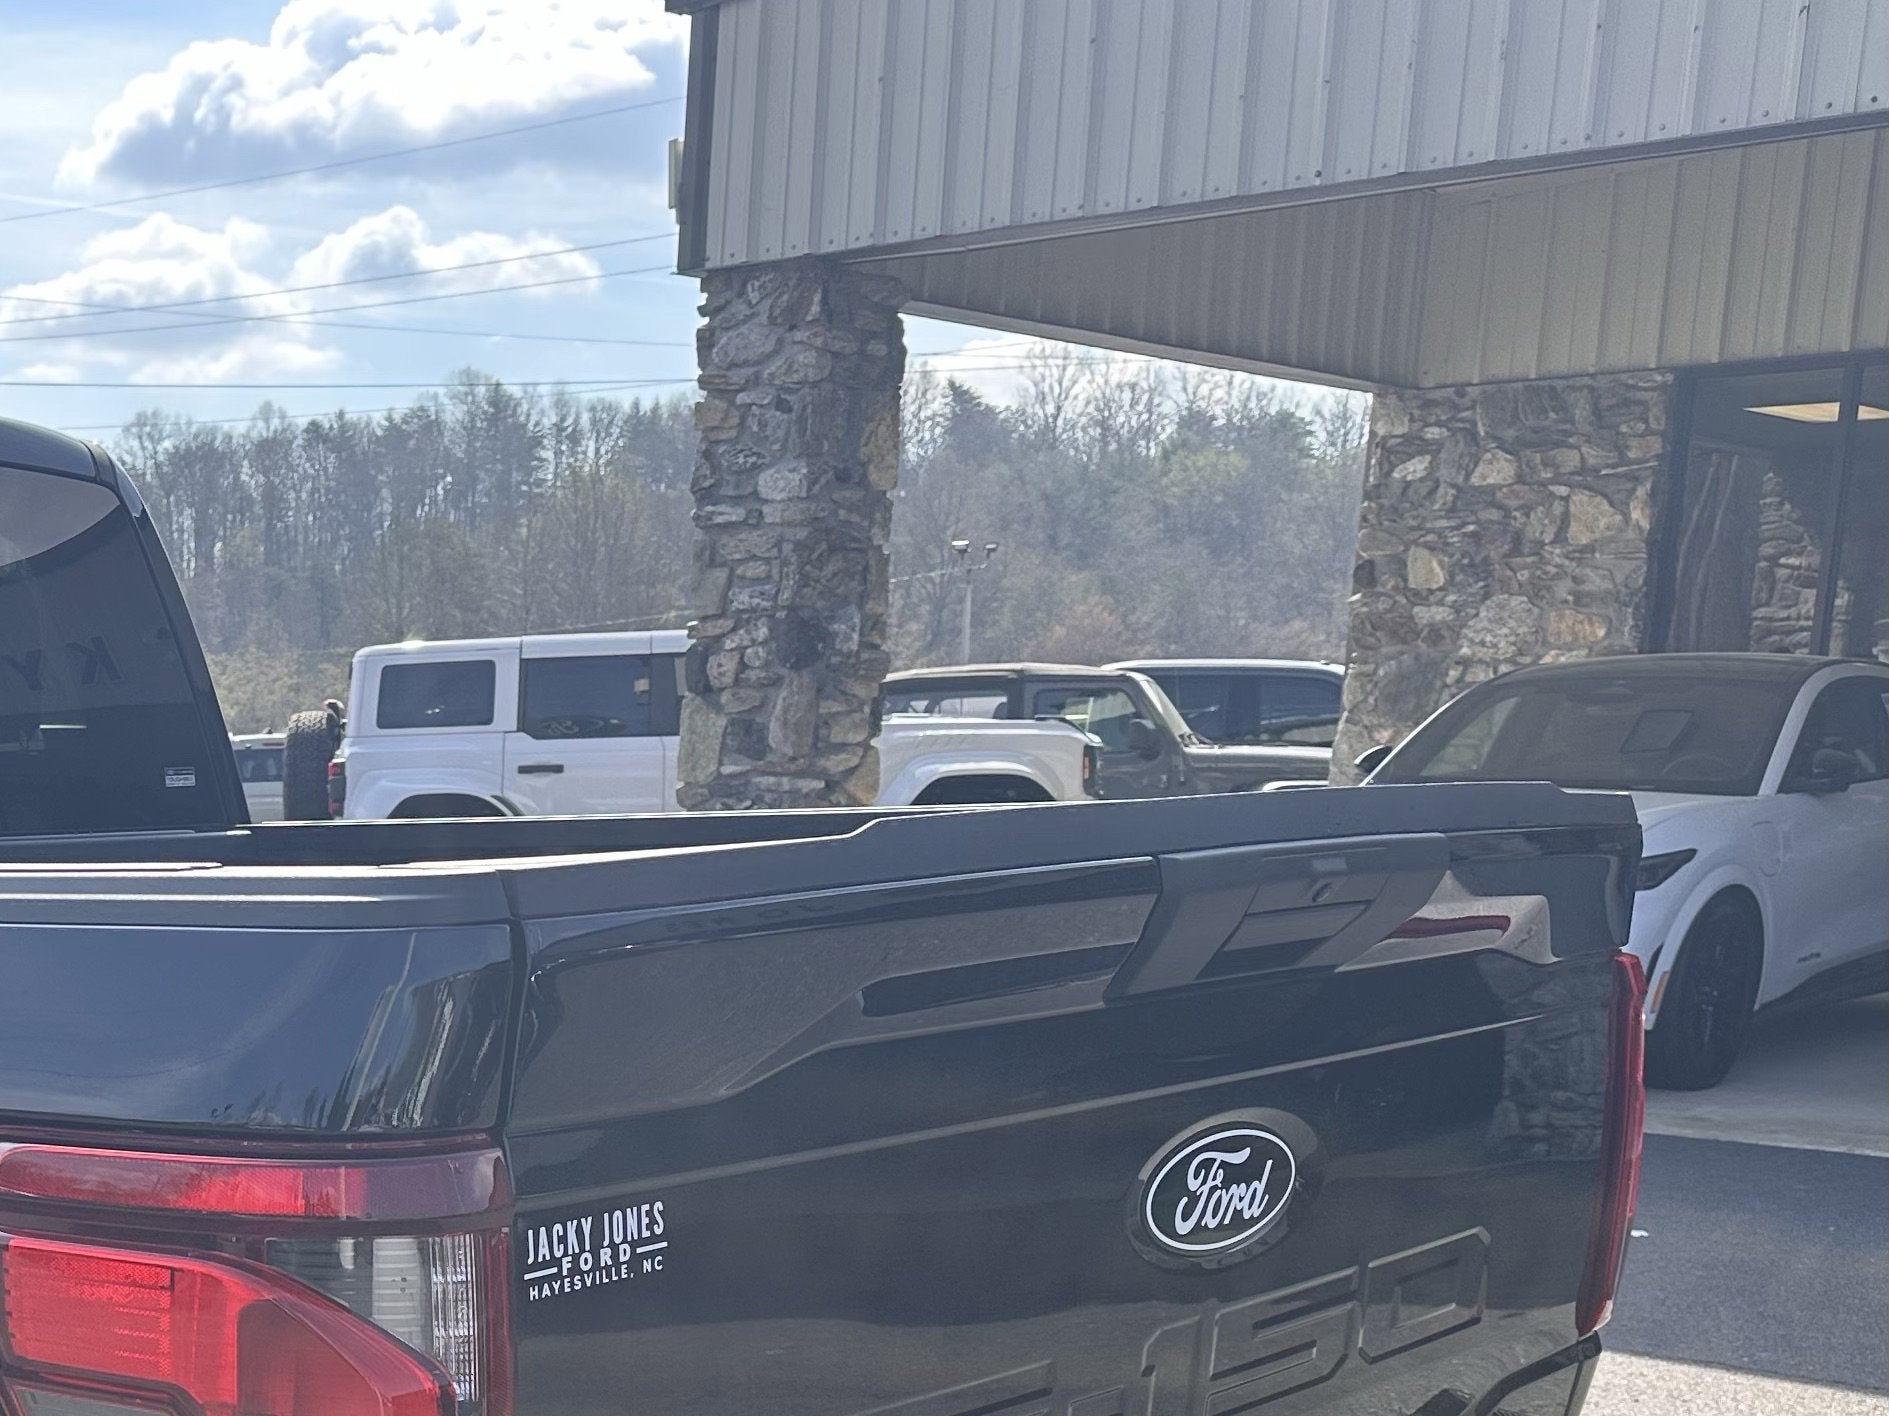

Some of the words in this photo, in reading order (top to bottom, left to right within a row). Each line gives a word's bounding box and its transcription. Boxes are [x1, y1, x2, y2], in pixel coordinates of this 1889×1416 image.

[1174, 1146, 1274, 1236] Ford
[527, 1216, 593, 1265] JACKY
[602, 1201, 665, 1248] JONES
[562, 1243, 632, 1277] FORD
[529, 1264, 635, 1302] HAYESVILLE,
[642, 1256, 664, 1274] NC
